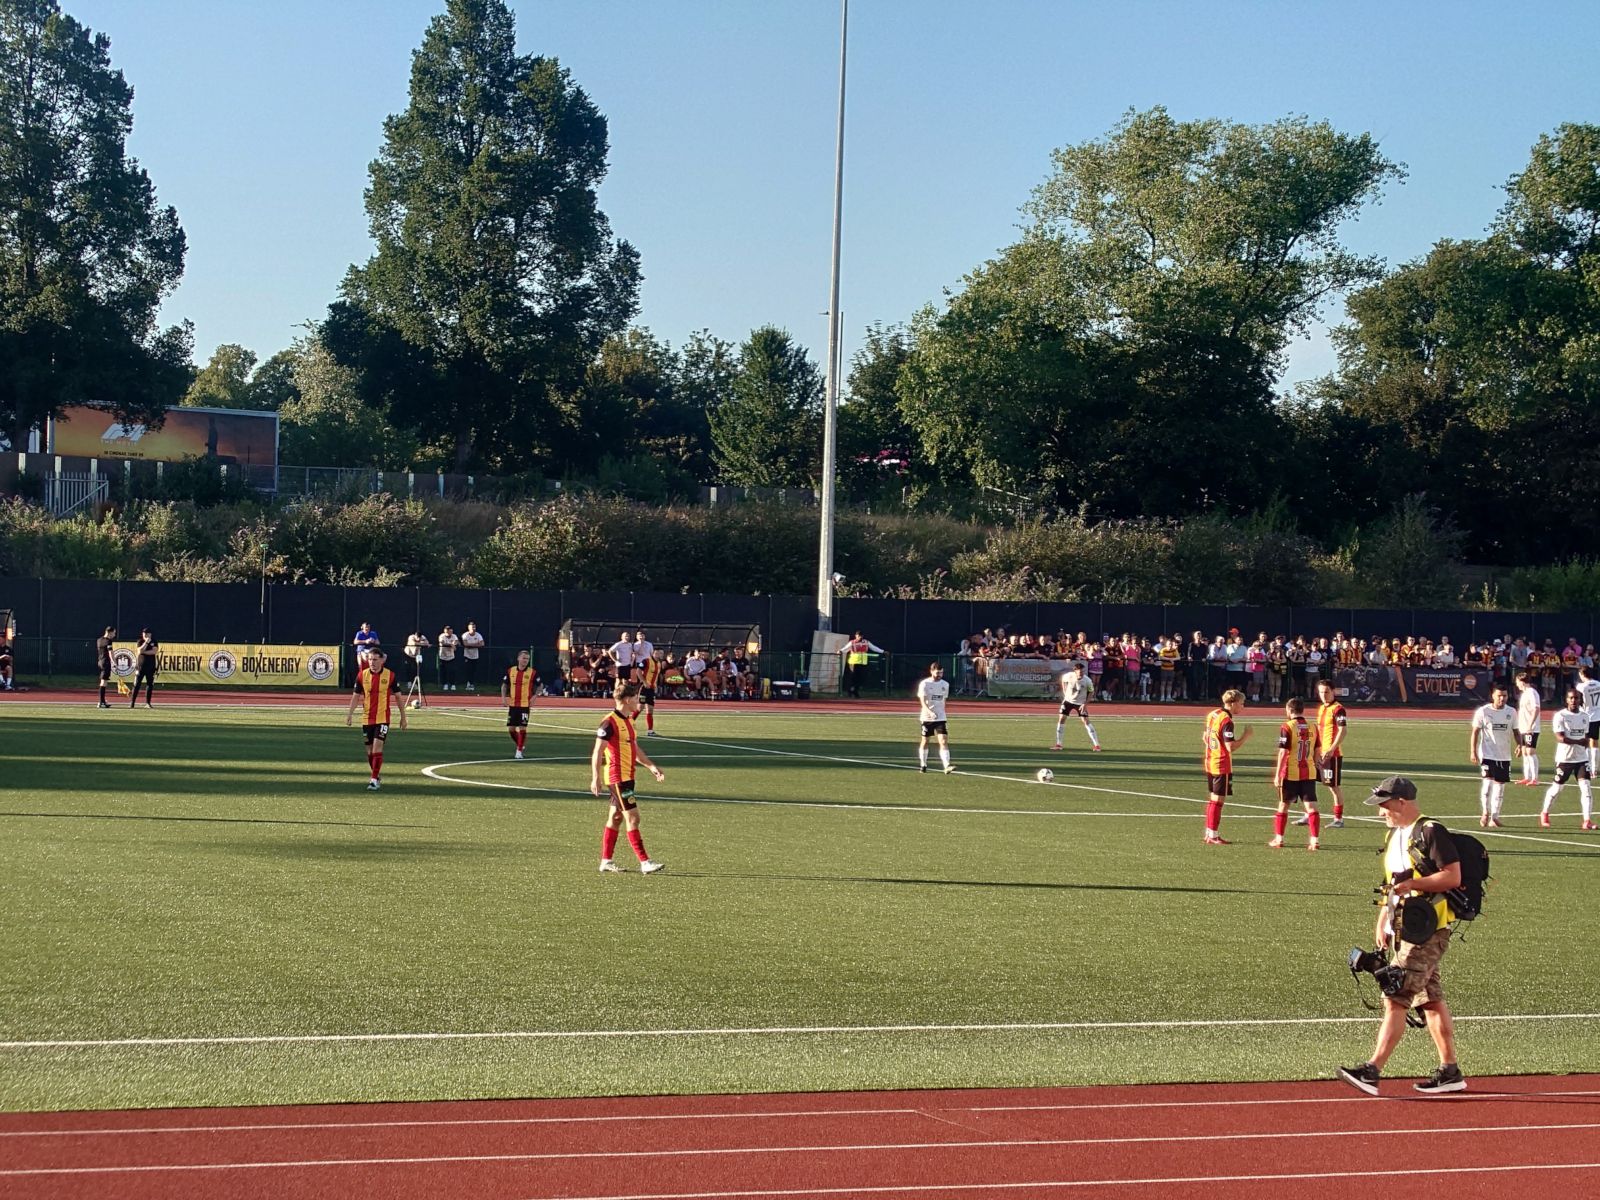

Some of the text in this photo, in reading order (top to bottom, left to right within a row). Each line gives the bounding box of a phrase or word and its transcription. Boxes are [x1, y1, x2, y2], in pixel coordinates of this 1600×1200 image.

[156, 653, 202, 675] XENERGY
[242, 653, 301, 676] BOXENERGY
[994, 673, 1052, 681] ONE MEMBERSHIP
[1416, 678, 1461, 693] EVOLVE
[380, 724, 388, 735] 19
[1323, 769, 1333, 779] 10
